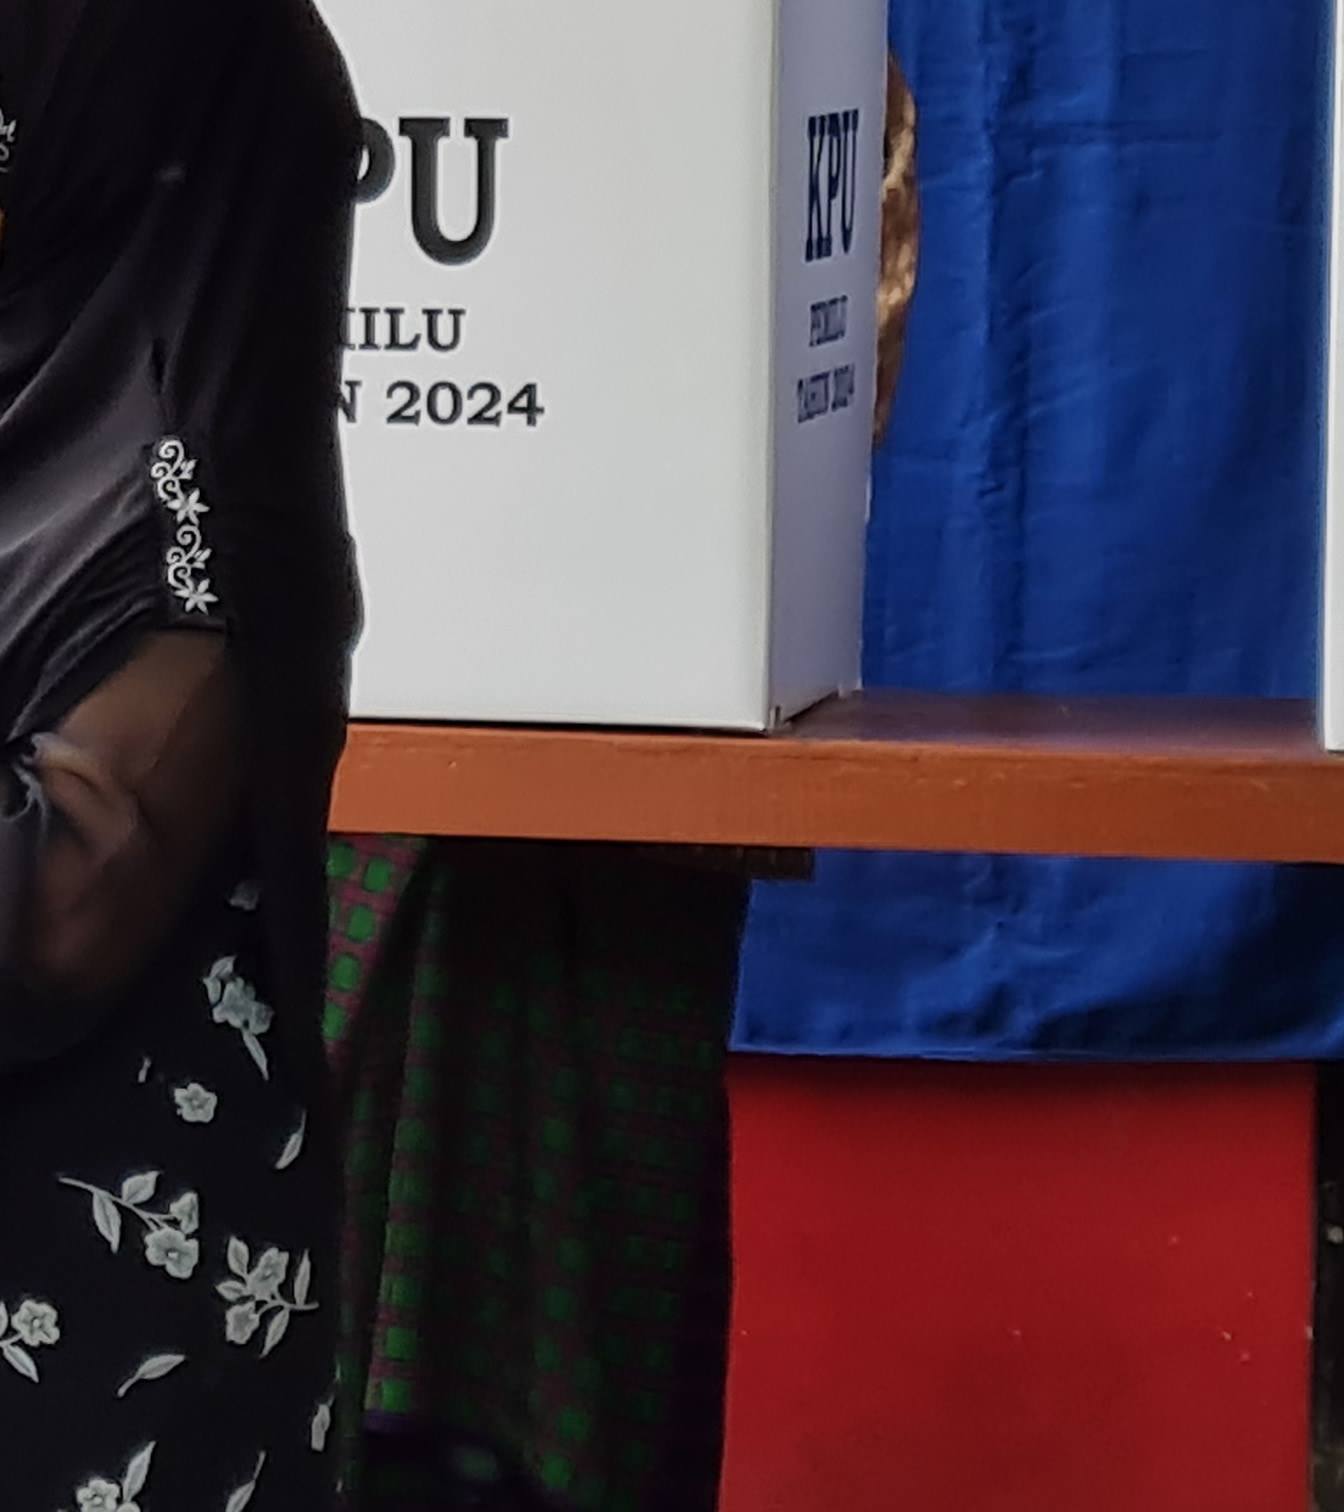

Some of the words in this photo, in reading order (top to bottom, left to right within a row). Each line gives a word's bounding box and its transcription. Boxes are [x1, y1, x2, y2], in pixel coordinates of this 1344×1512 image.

[354, 116, 509, 267] PU
[805, 108, 859, 262] KPU
[343, 306, 466, 352] ILU
[386, 380, 545, 426] 2024
